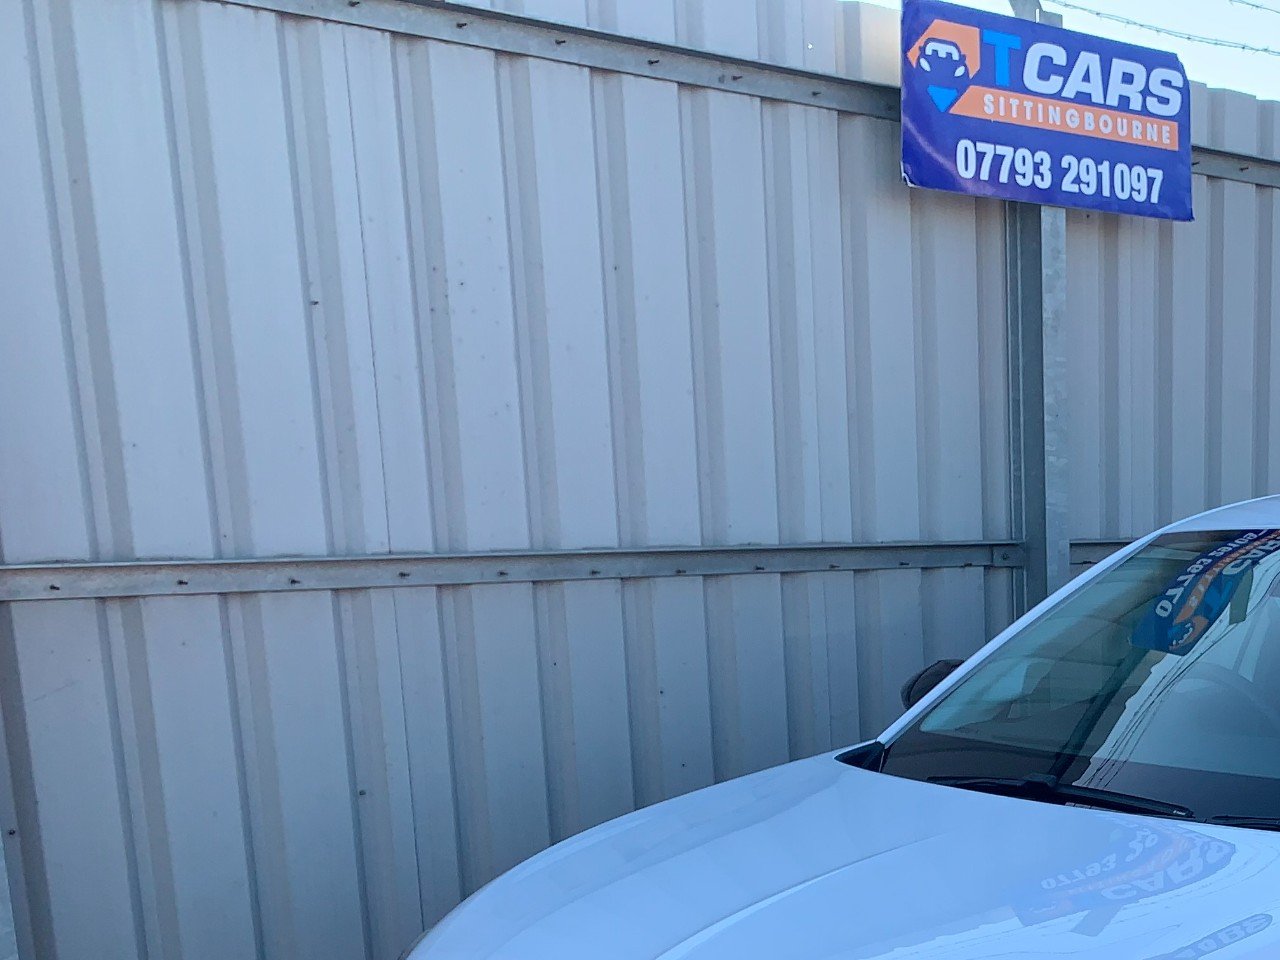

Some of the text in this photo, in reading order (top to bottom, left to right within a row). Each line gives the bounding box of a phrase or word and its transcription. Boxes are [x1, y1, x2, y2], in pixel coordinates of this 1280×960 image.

[983, 94, 1171, 145] SITTINGBOURNE
[956, 139, 1164, 204] 07793 291097
